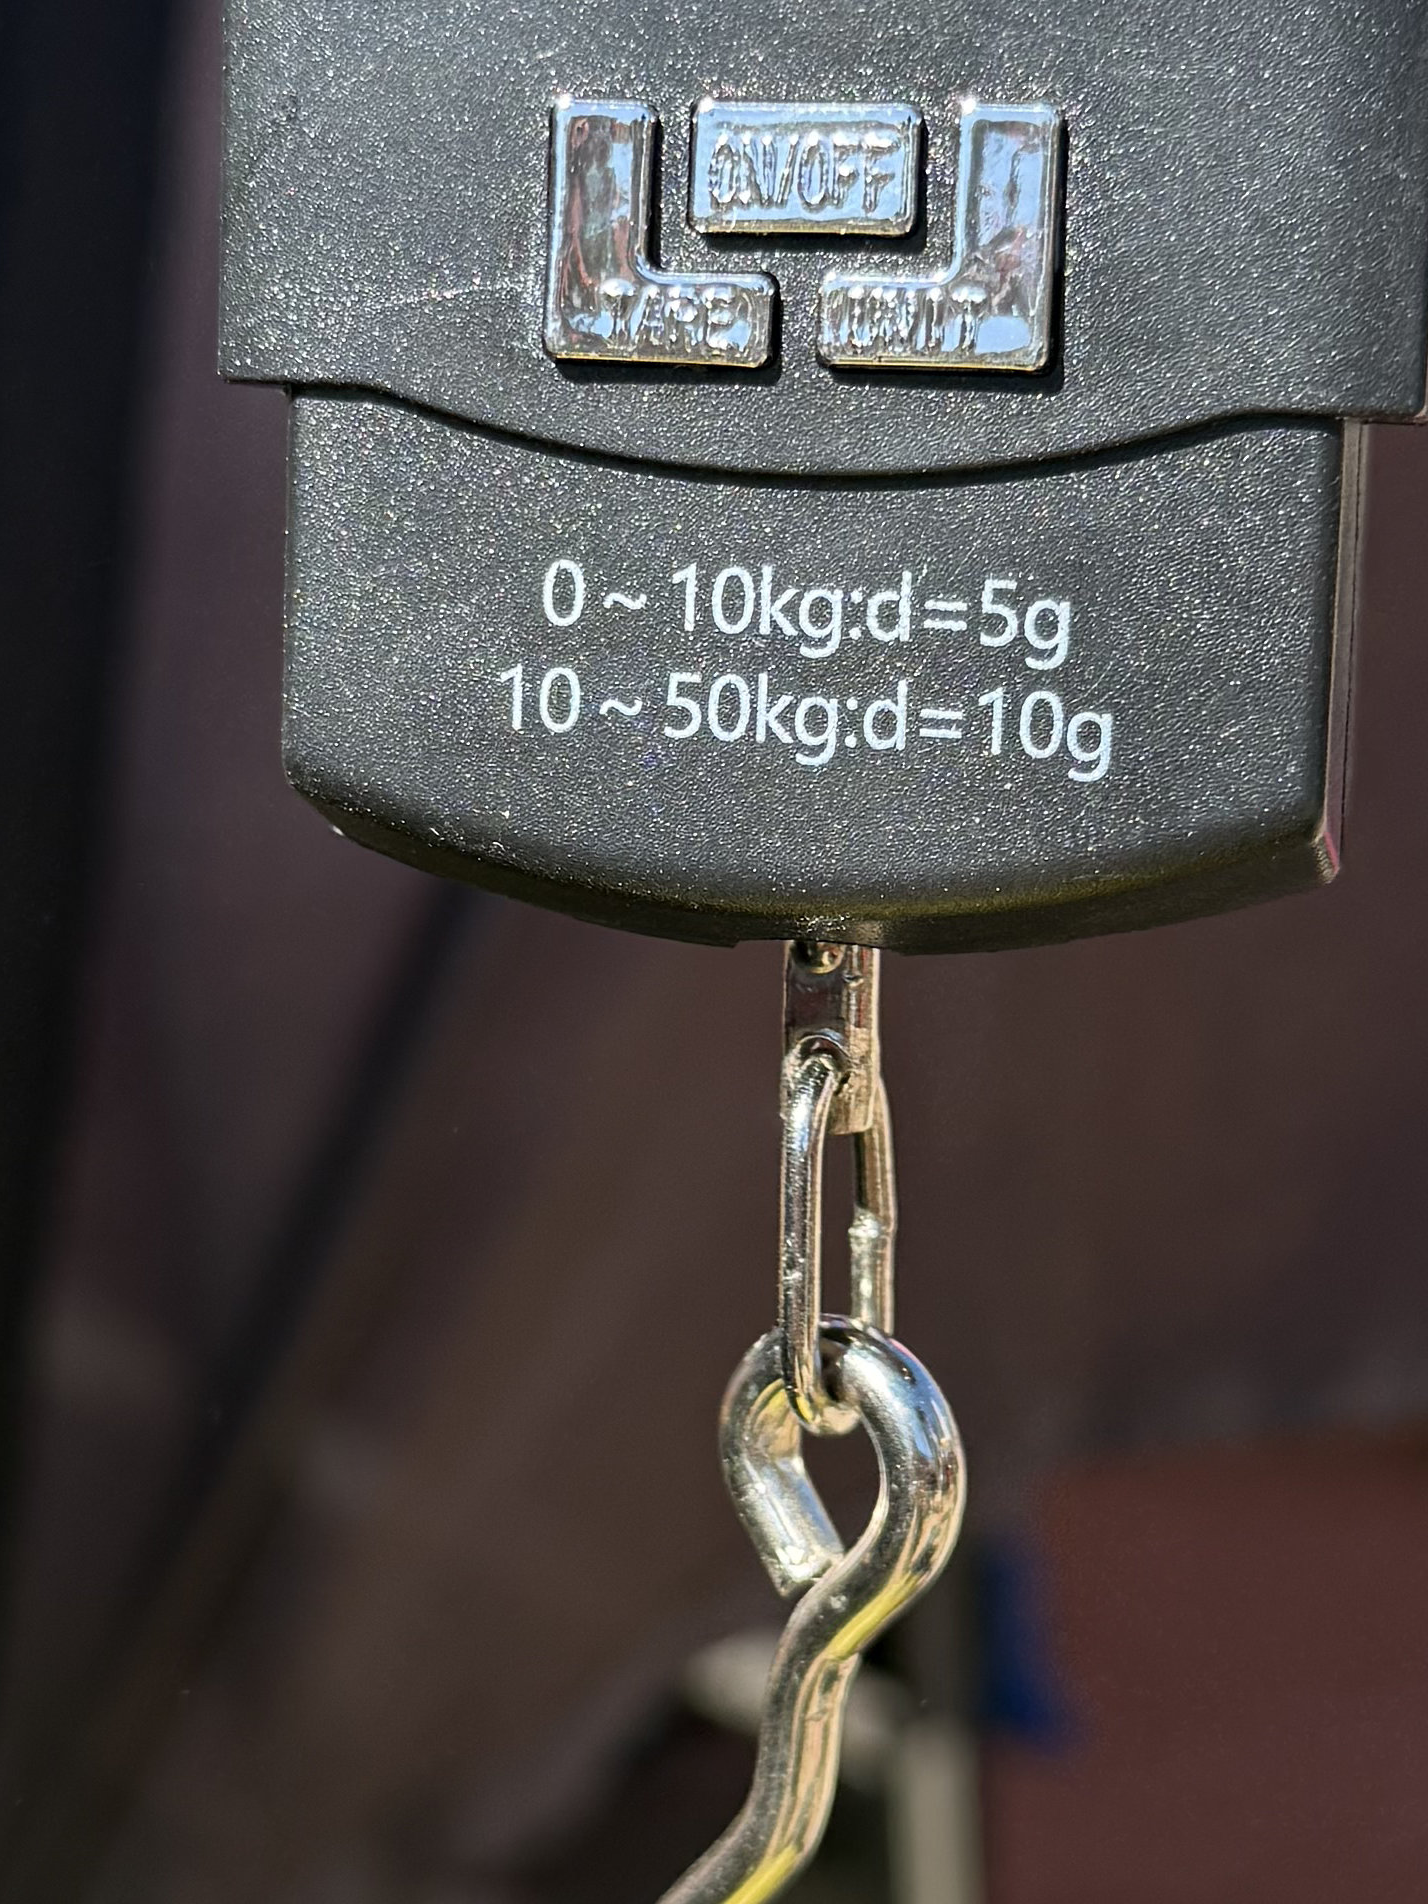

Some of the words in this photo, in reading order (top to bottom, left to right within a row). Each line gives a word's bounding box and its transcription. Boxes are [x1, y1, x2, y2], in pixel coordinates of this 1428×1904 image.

[708, 131, 899, 212] ON/OFF
[542, 559, 585, 627] 0
[673, 563, 1072, 671] 10kg:d=5g
[500, 666, 581, 733] 10
[663, 672, 1114, 782] 50kg:d=10g
